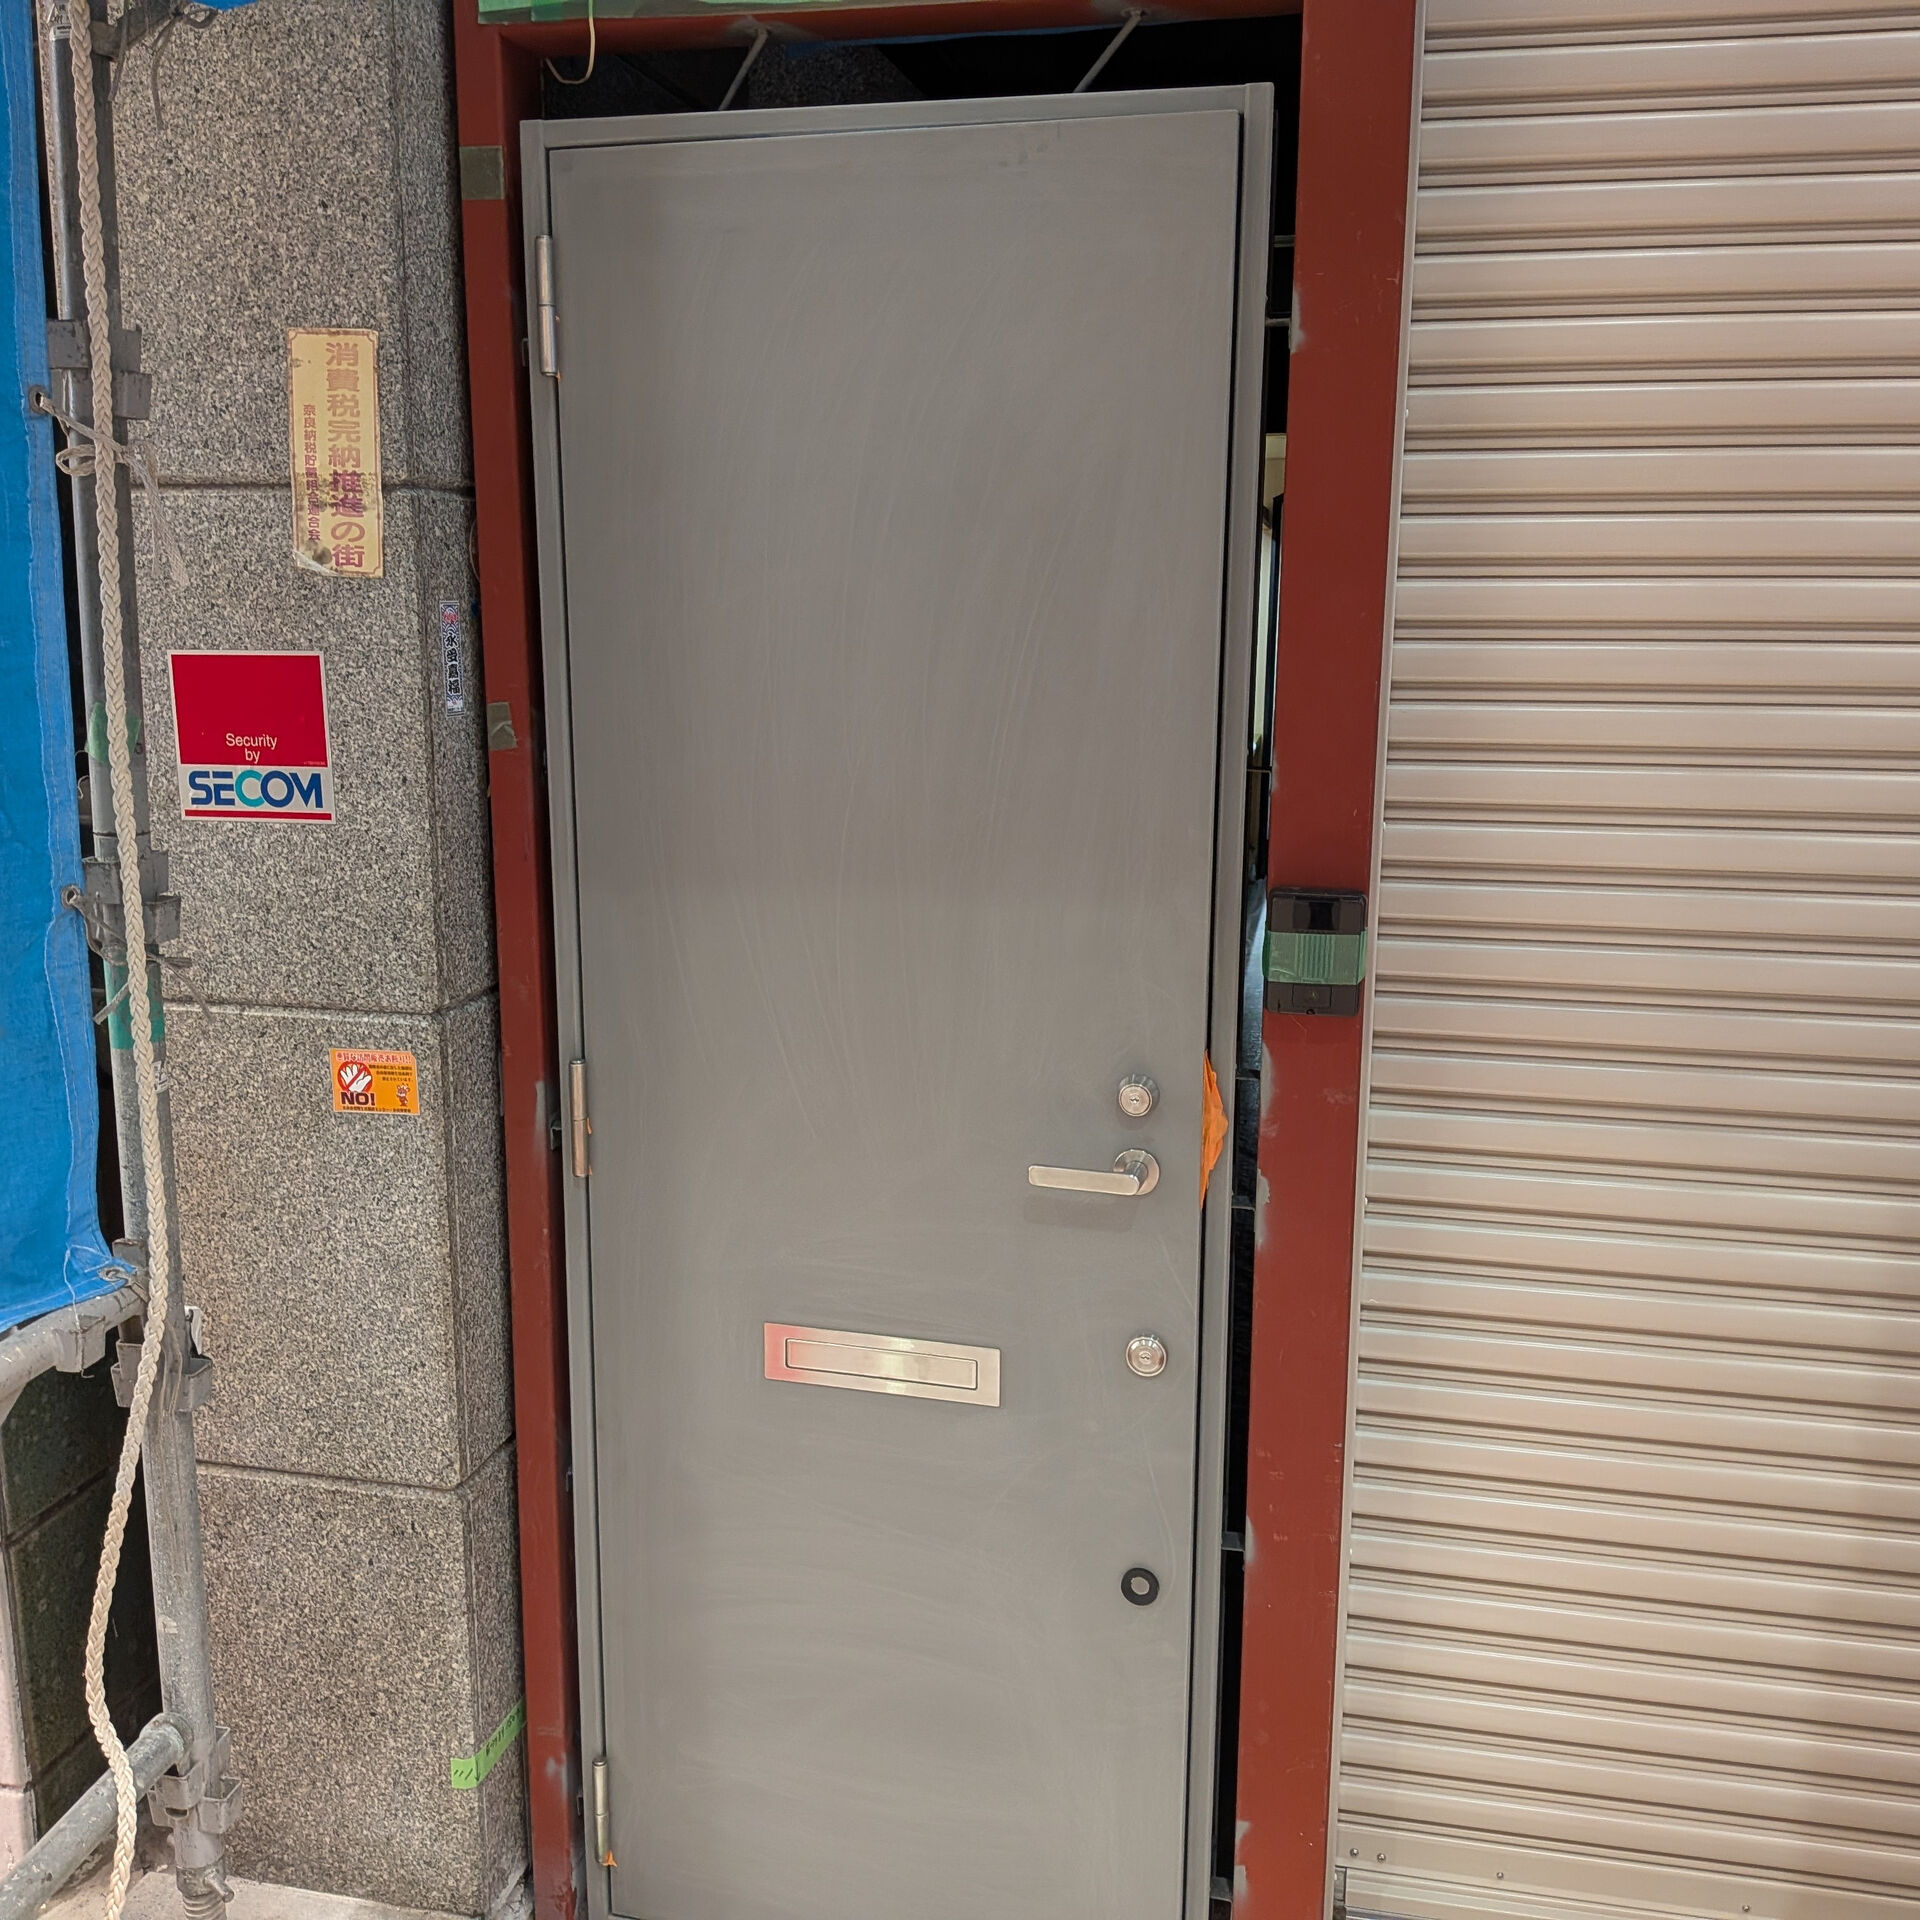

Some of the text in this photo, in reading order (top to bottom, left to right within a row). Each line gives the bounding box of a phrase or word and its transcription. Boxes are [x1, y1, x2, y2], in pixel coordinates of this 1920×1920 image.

[326, 342, 365, 568] 消費税完納推進の街
[225, 732, 277, 750] Security
[244, 748, 260, 764] by
[188, 769, 323, 808] SECOM
[340, 1091, 376, 1106] NO!
